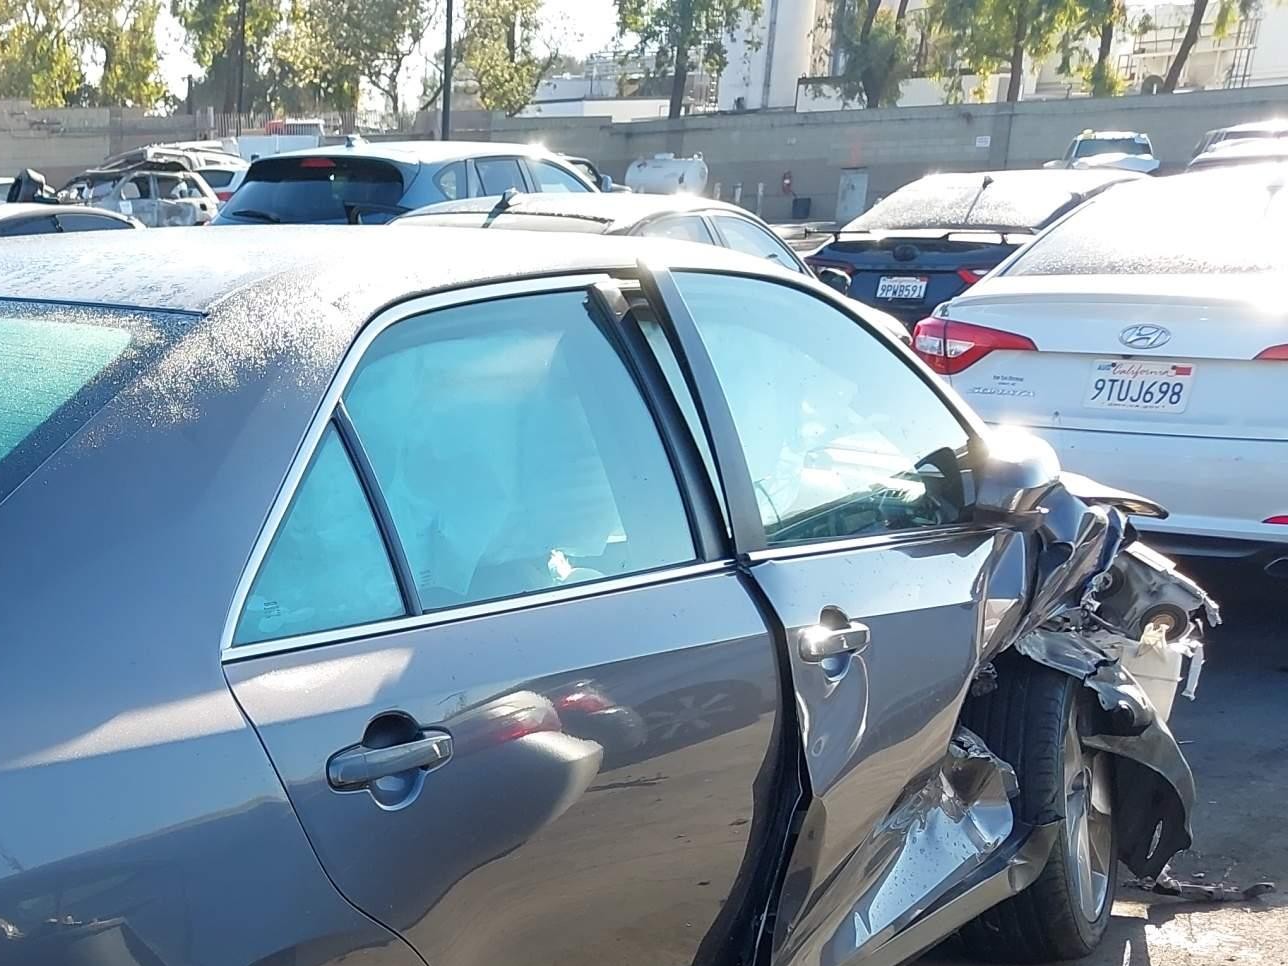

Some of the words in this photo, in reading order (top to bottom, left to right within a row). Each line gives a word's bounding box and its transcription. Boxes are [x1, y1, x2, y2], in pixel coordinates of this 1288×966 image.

[879, 284, 923, 298] 9PWB591
[1112, 362, 1170, 379] California
[1090, 378, 1185, 405] 9TUJ698
